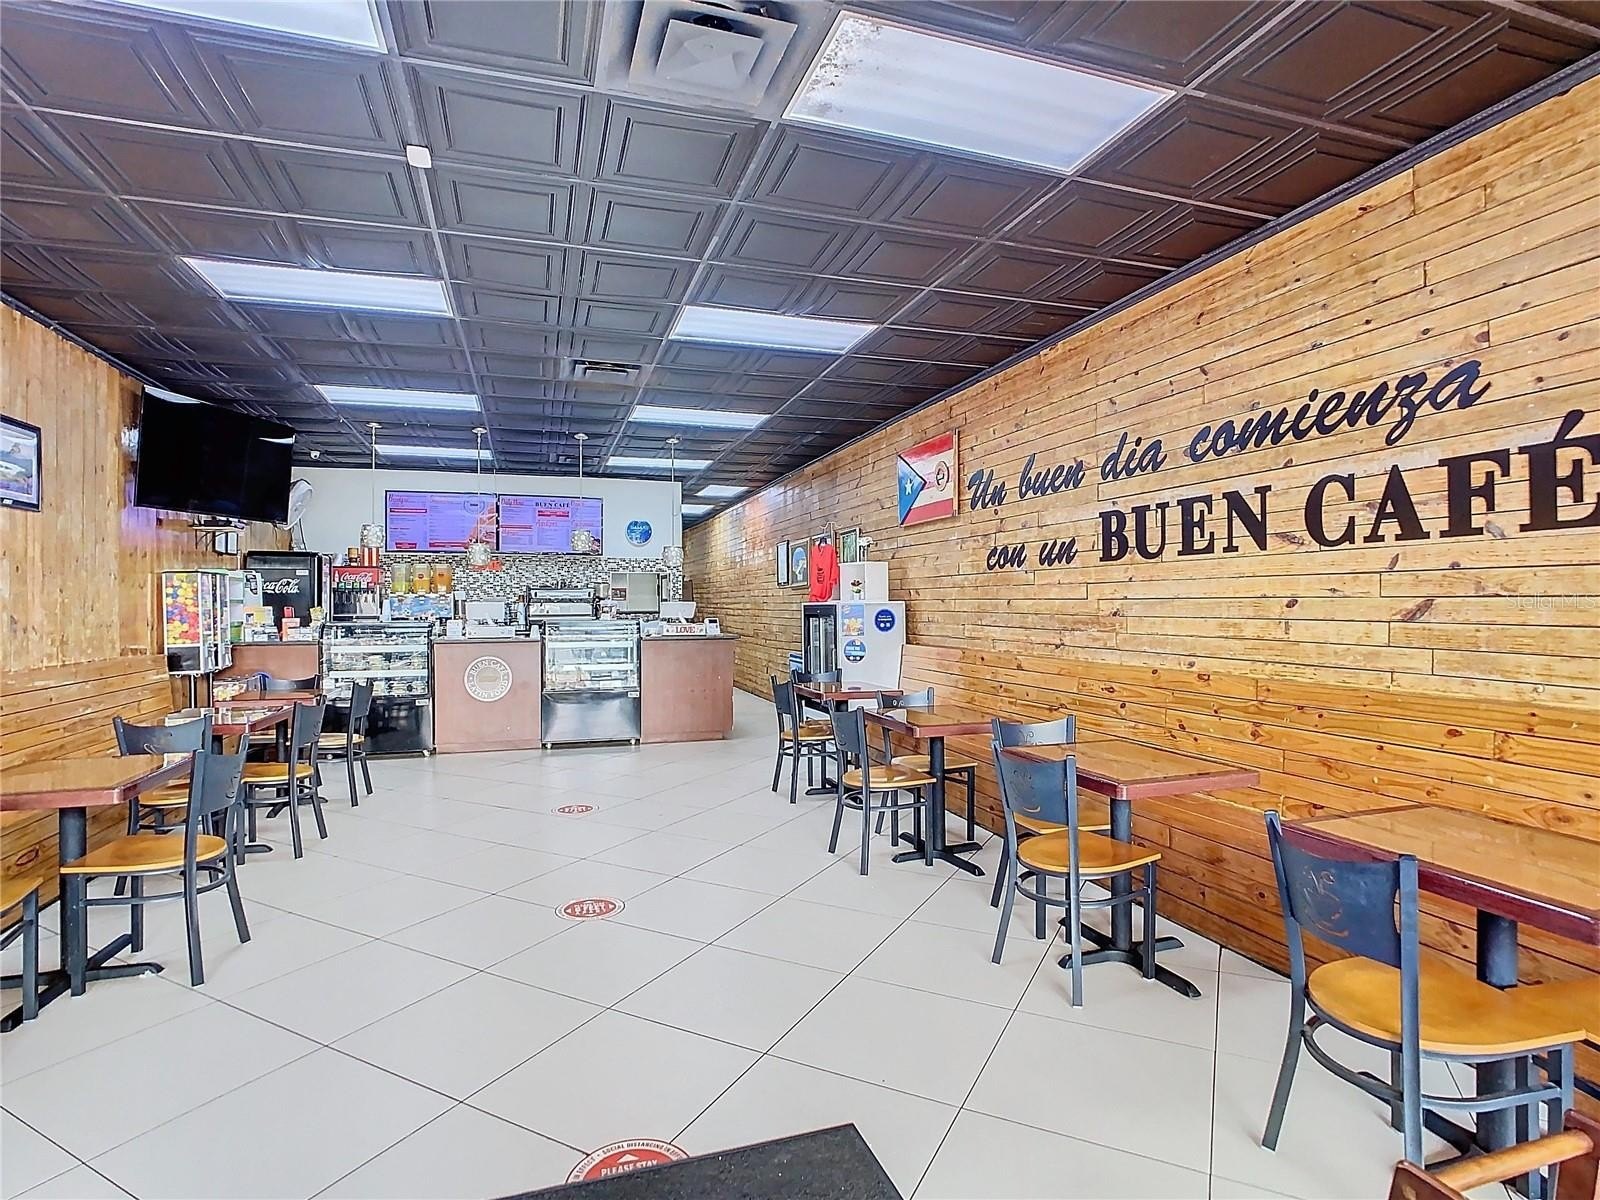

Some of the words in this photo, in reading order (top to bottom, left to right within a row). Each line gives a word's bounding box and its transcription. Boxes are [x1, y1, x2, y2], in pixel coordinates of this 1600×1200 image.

[967, 469, 1007, 511] Un
[1019, 453, 1086, 500] buen
[1100, 432, 1168, 481] dia
[1188, 359, 1493, 463] comienza
[986, 542, 1027, 571] con
[1037, 537, 1078, 567] un
[1098, 484, 1272, 563] BUEN
[1303, 409, 1600, 547] CAFÉ
[675, 626, 696, 634] LOVE
[602, 1143, 625, 1155] SOCIAL
[626, 1141, 664, 1149] DISTANCING
